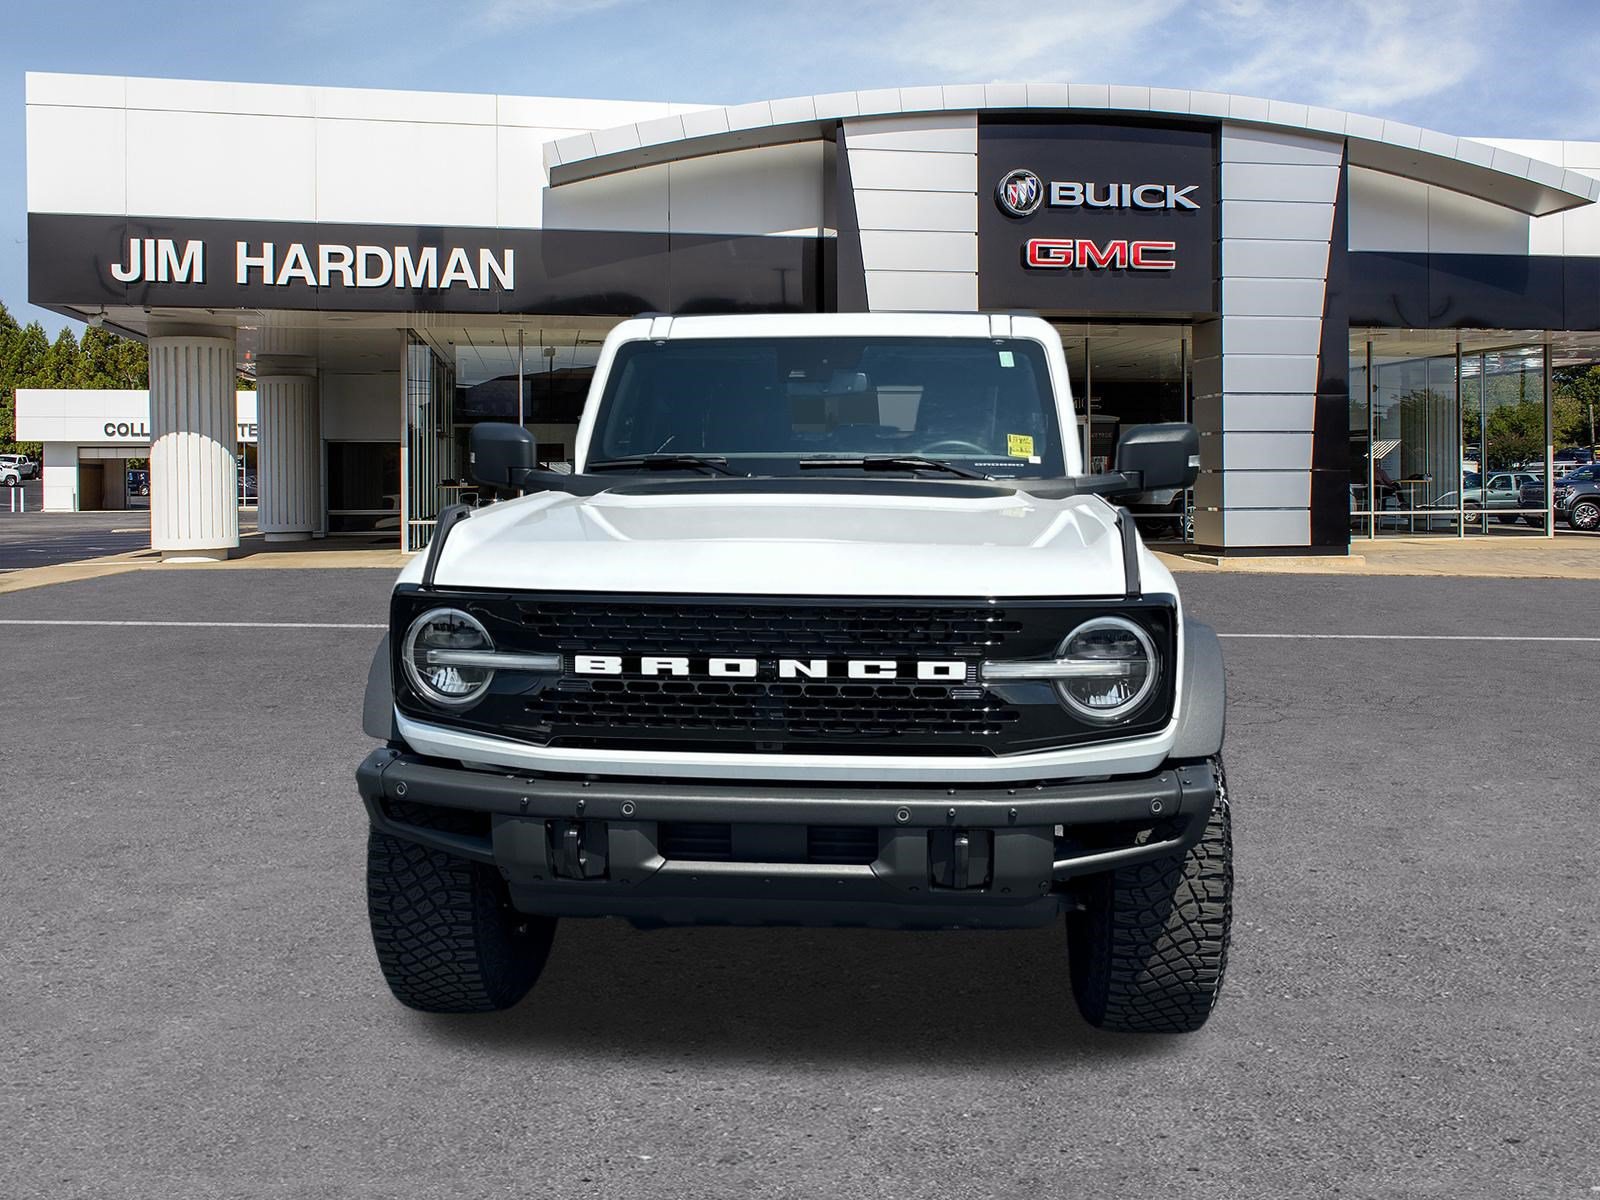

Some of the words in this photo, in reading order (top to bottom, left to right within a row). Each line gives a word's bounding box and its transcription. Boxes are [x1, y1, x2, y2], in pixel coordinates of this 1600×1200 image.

[1050, 181, 1200, 209] BUICK
[110, 238, 205, 284] JIM
[235, 240, 515, 291] HARDMAN
[1026, 238, 1176, 270] GMC
[574, 655, 967, 682] BRONCO
